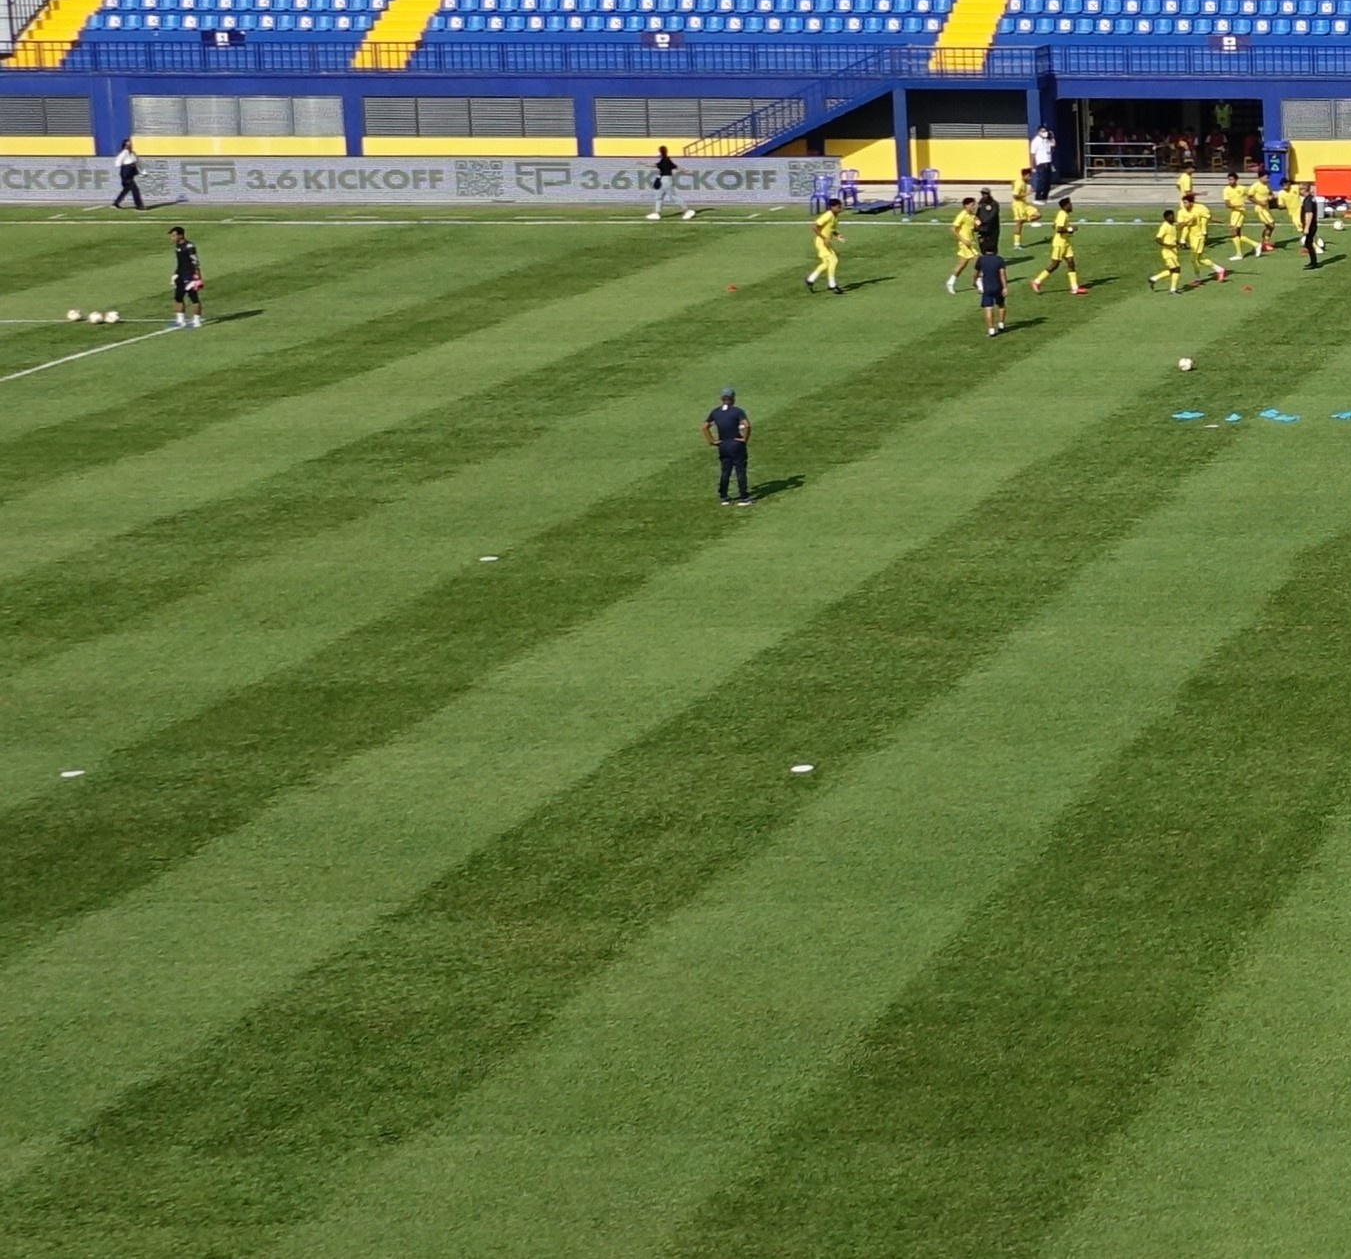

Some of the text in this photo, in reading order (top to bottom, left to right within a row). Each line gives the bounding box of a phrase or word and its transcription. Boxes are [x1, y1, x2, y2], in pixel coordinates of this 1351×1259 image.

[246, 168, 444, 190] 3.6 KICKOFF
[581, 168, 777, 190] 3.6 KCKOFF
